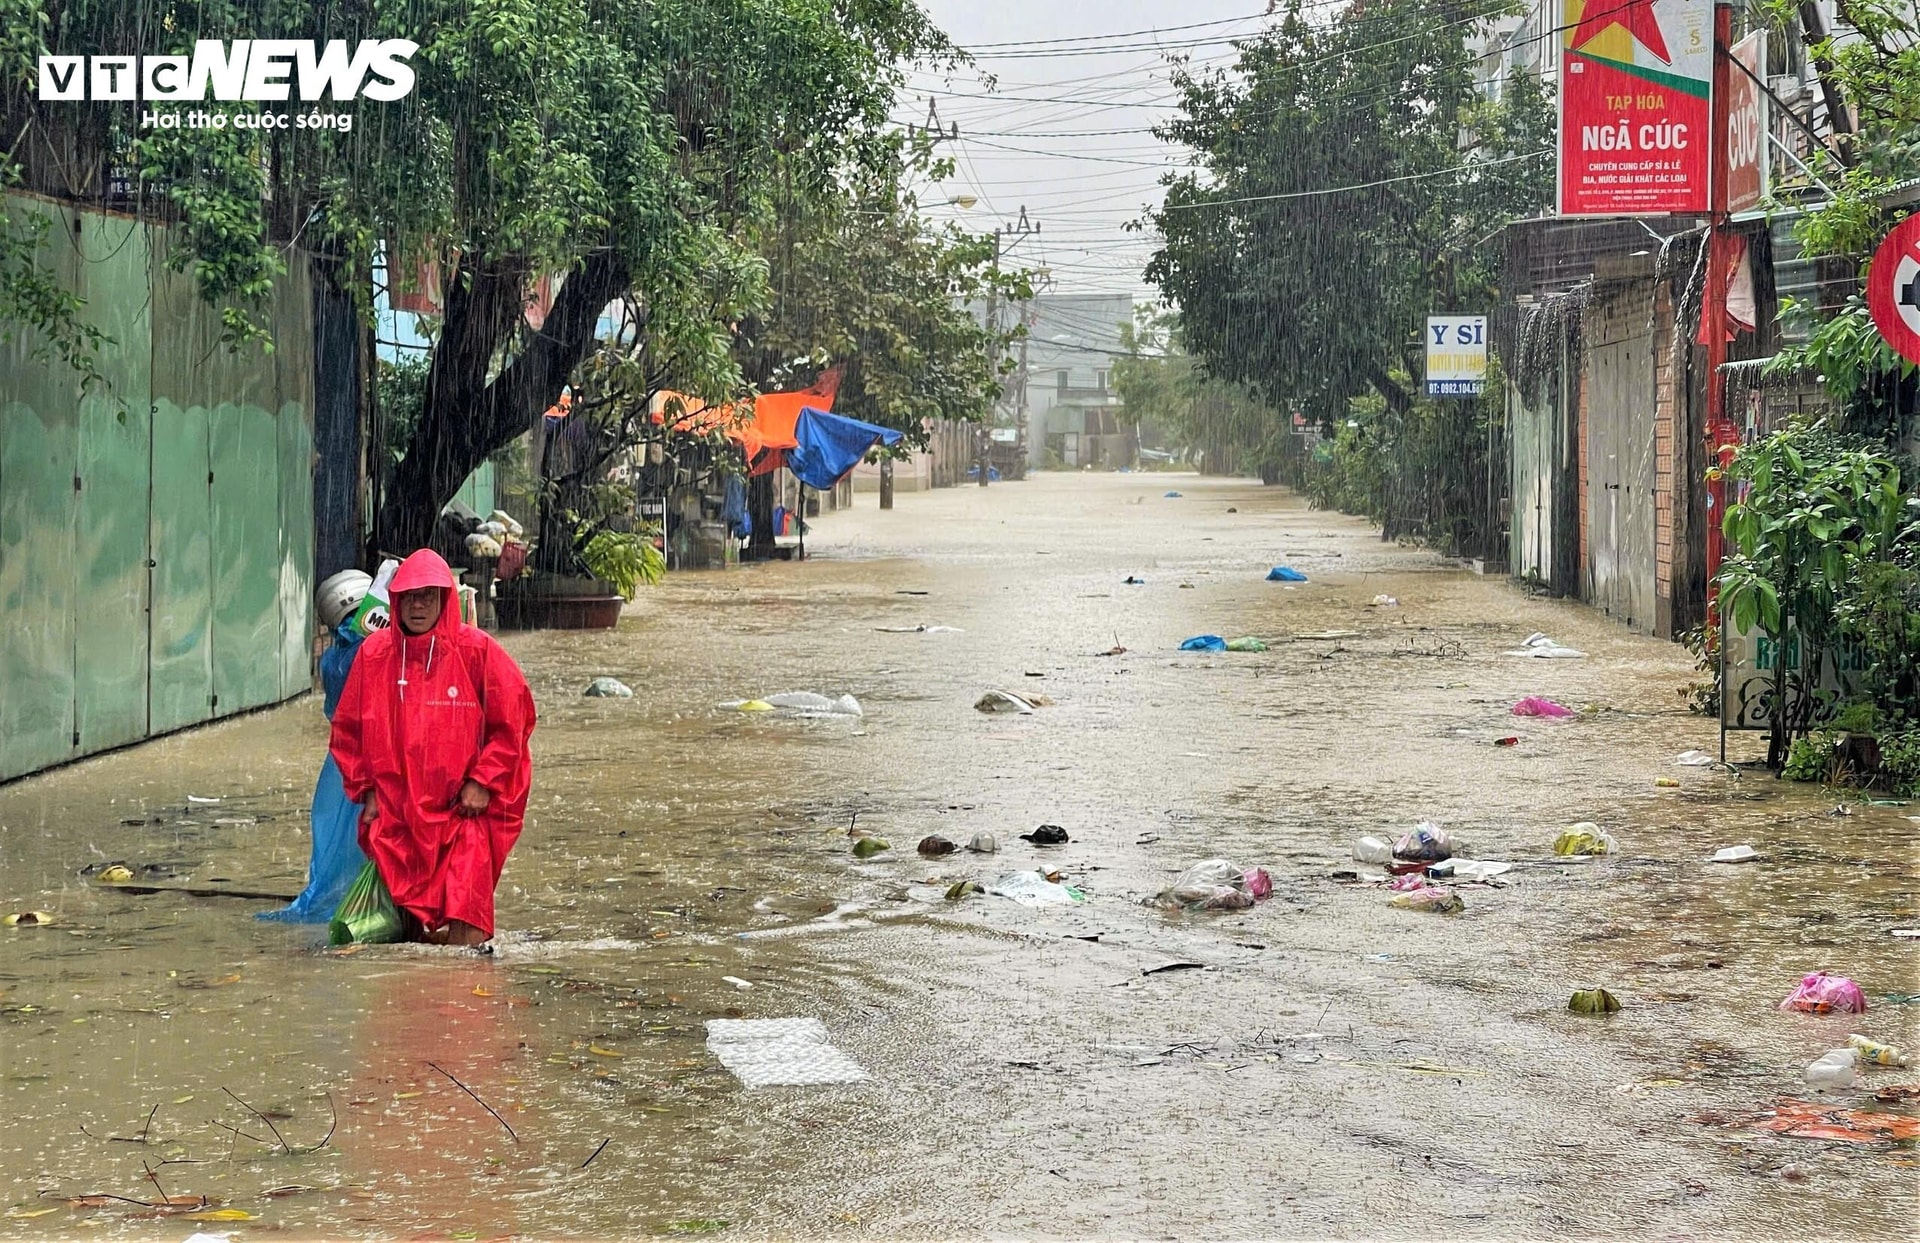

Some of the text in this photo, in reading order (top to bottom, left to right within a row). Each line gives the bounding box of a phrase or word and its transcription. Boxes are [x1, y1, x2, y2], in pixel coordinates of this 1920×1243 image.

[1606, 92, 1665, 115] TẠP HÓA
[1582, 118, 1688, 151] NGÃ CÚC
[1728, 88, 1758, 172] CÚC
[1589, 161, 1617, 171] CHUYÊN
[1618, 162, 1638, 171] CUNG
[1639, 160, 1654, 170] CẤP
[1583, 175, 1597, 185] BIA,
[1619, 173, 1634, 183] GIẢI
[1634, 173, 1653, 183] KHÁT
[1655, 173, 1669, 183] CÁC
[1670, 173, 1687, 184] LOẠI
[1431, 319, 1483, 345] Y SĨ
[368, 612, 391, 629] MI
